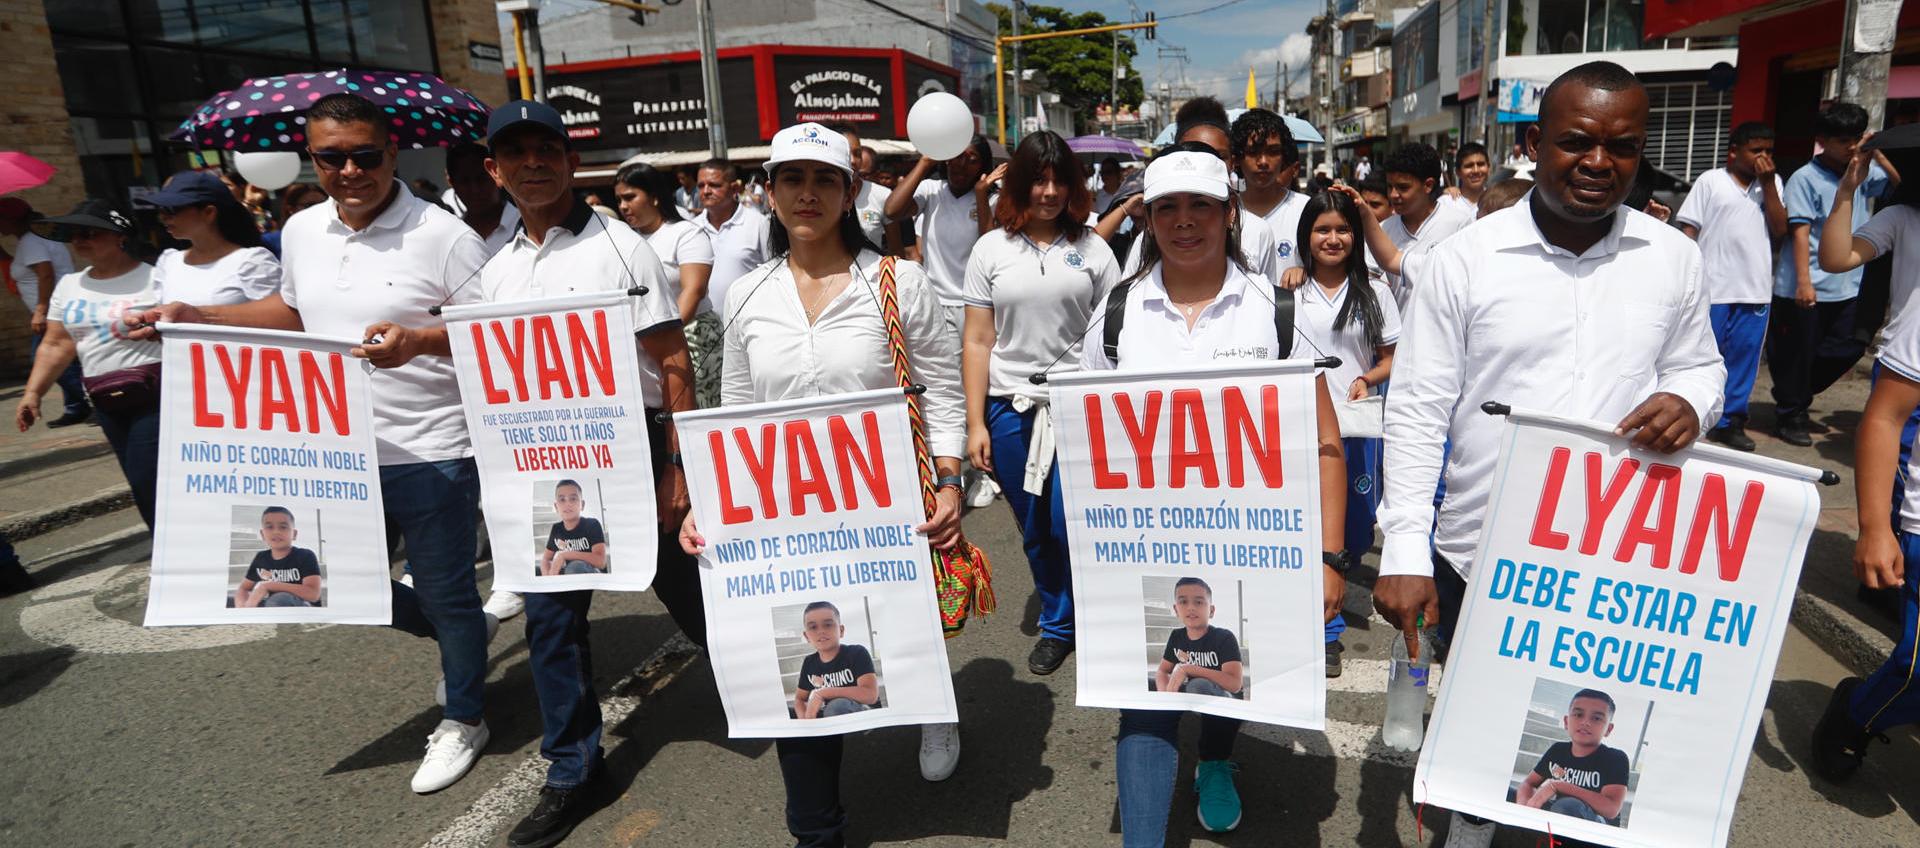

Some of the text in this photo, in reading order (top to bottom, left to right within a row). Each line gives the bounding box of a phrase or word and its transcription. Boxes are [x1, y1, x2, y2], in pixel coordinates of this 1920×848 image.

[791, 70, 882, 94] EL PALACIO DE LA
[470, 310, 616, 404] LYAN
[190, 343, 350, 436] LYAN
[483, 406, 628, 425] FUE SECUESTRADO POR LA GUERRILLA.
[502, 421, 615, 445] TIENE SOLO 11 AÑOS
[1084, 384, 1283, 489] LYAN
[180, 440, 367, 472] NIÑO DE CORAZÓN NOBLE
[514, 444, 613, 472] LIBERTAD YA
[709, 411, 892, 524] LYAN
[185, 466, 368, 500] MAMÁ PIDE TU LIBERTAD
[1084, 499, 1304, 533] NIÑO DE CORAZÓN NOBLE
[1529, 446, 1765, 582] LYAN
[716, 522, 913, 563] NIÑO DE CORAZÓN NOBLE
[1094, 534, 1304, 570] MAMÁ PIDE TU LIBERTAD
[726, 560, 918, 597] MAMÁ PIDE TU LIBERTAD
[1487, 556, 1758, 648] DEBE ESTAR EN
[1498, 615, 1704, 696] LA ESCUELA
